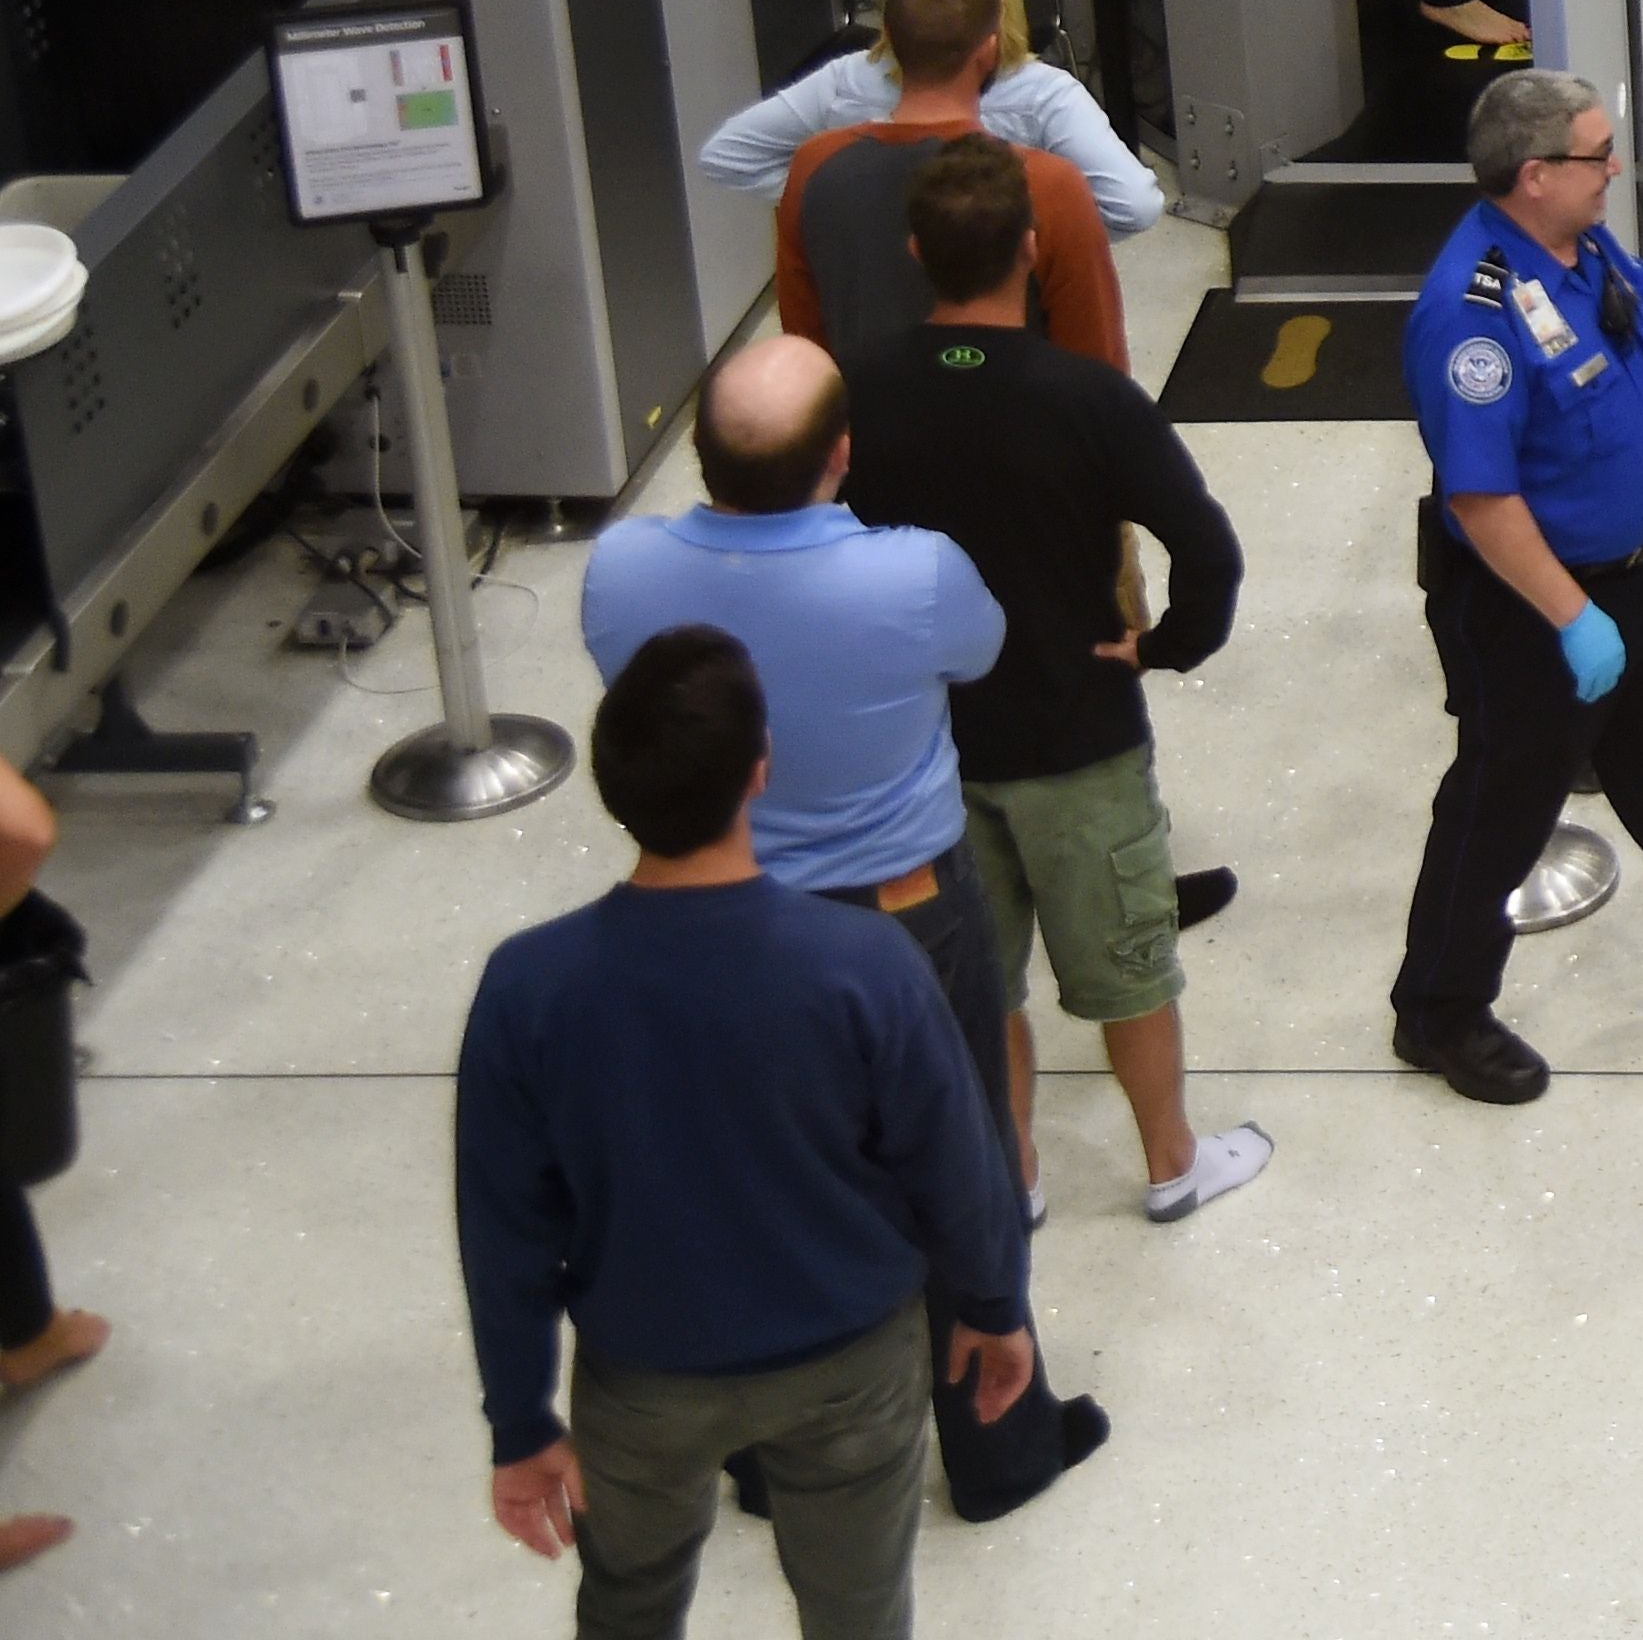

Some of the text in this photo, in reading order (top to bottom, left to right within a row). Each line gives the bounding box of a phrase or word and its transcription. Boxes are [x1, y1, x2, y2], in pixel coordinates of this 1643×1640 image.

[343, 26, 374, 36] Wave
[375, 20, 426, 32] Detection
[1473, 272, 1502, 289] TSA
